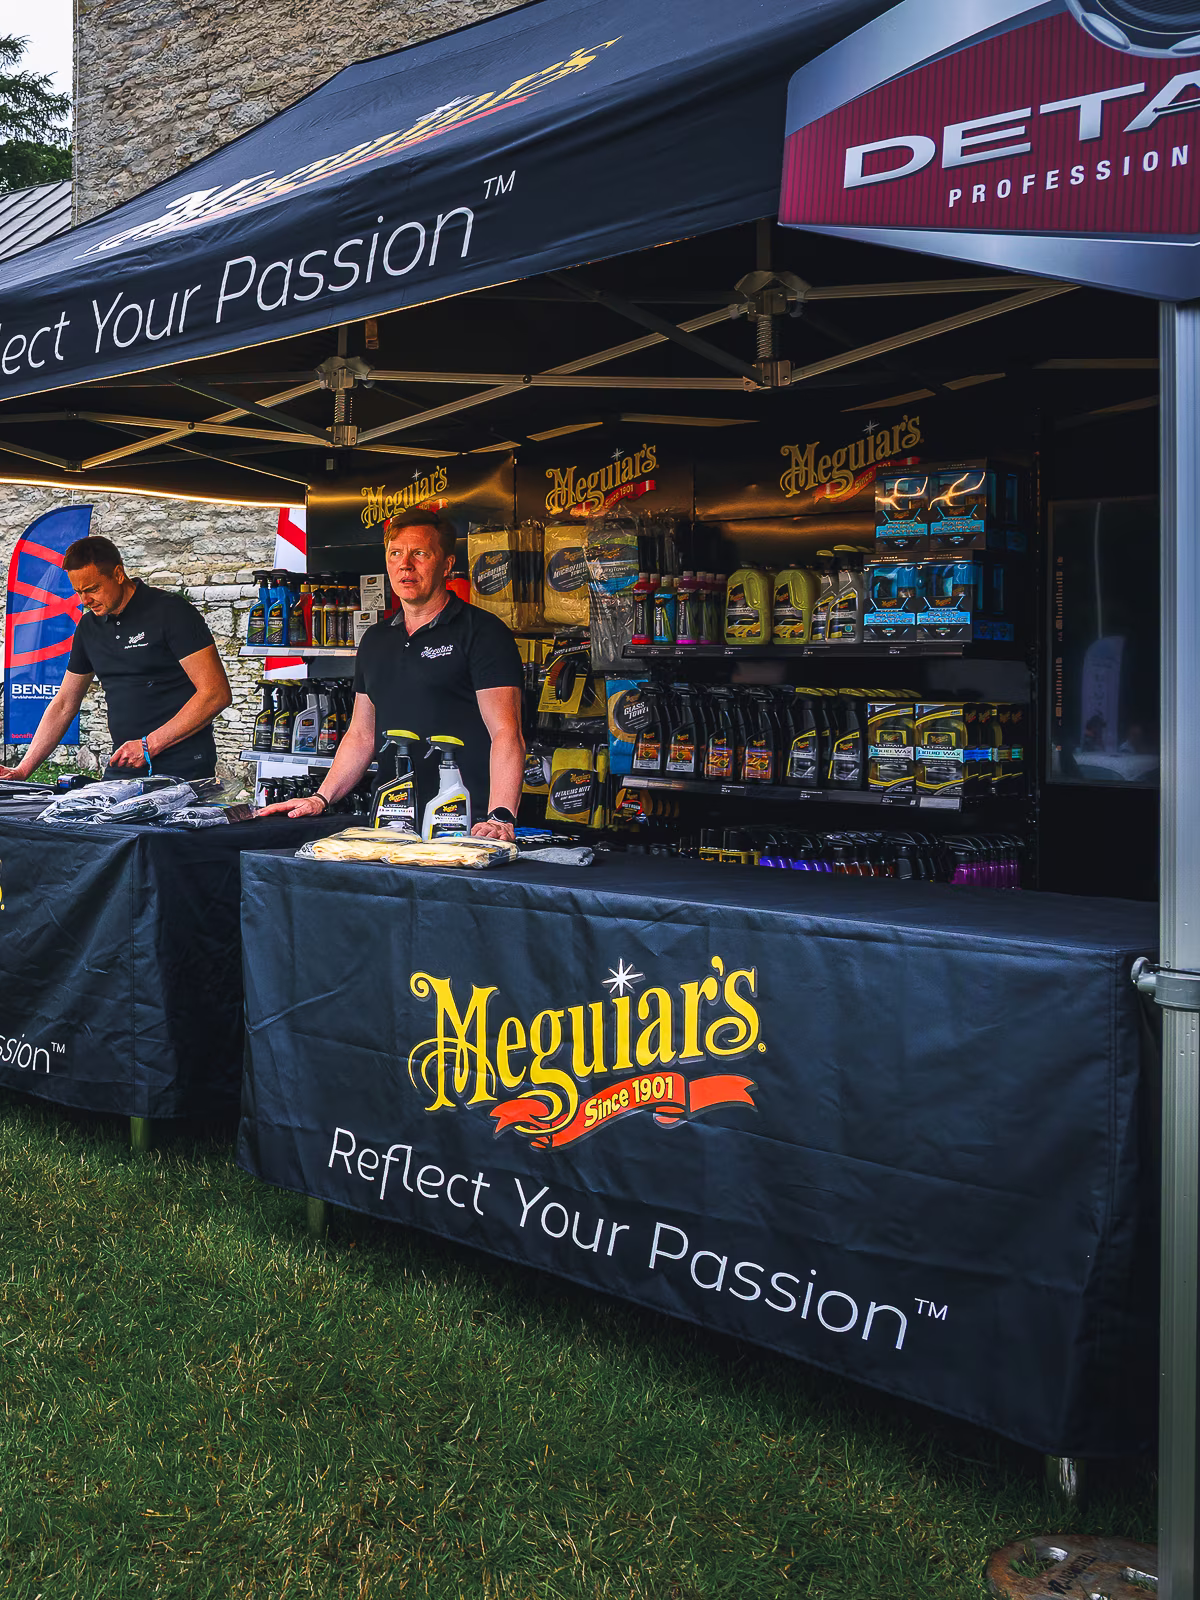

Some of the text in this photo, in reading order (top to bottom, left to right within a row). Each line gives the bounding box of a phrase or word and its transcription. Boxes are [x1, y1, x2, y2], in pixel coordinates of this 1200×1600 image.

[949, 145, 1189, 208] PROFESSION
[93, 284, 202, 354] Your
[545, 443, 657, 515] Meguiar's
[779, 414, 922, 498] Meguiar's
[361, 465, 448, 529] Meguiar's
[11, 683, 62, 696] BENEF
[584, 1075, 674, 1127] Since 1901
[328, 1126, 491, 1216] Reflect
[514, 1177, 630, 1257] Your
